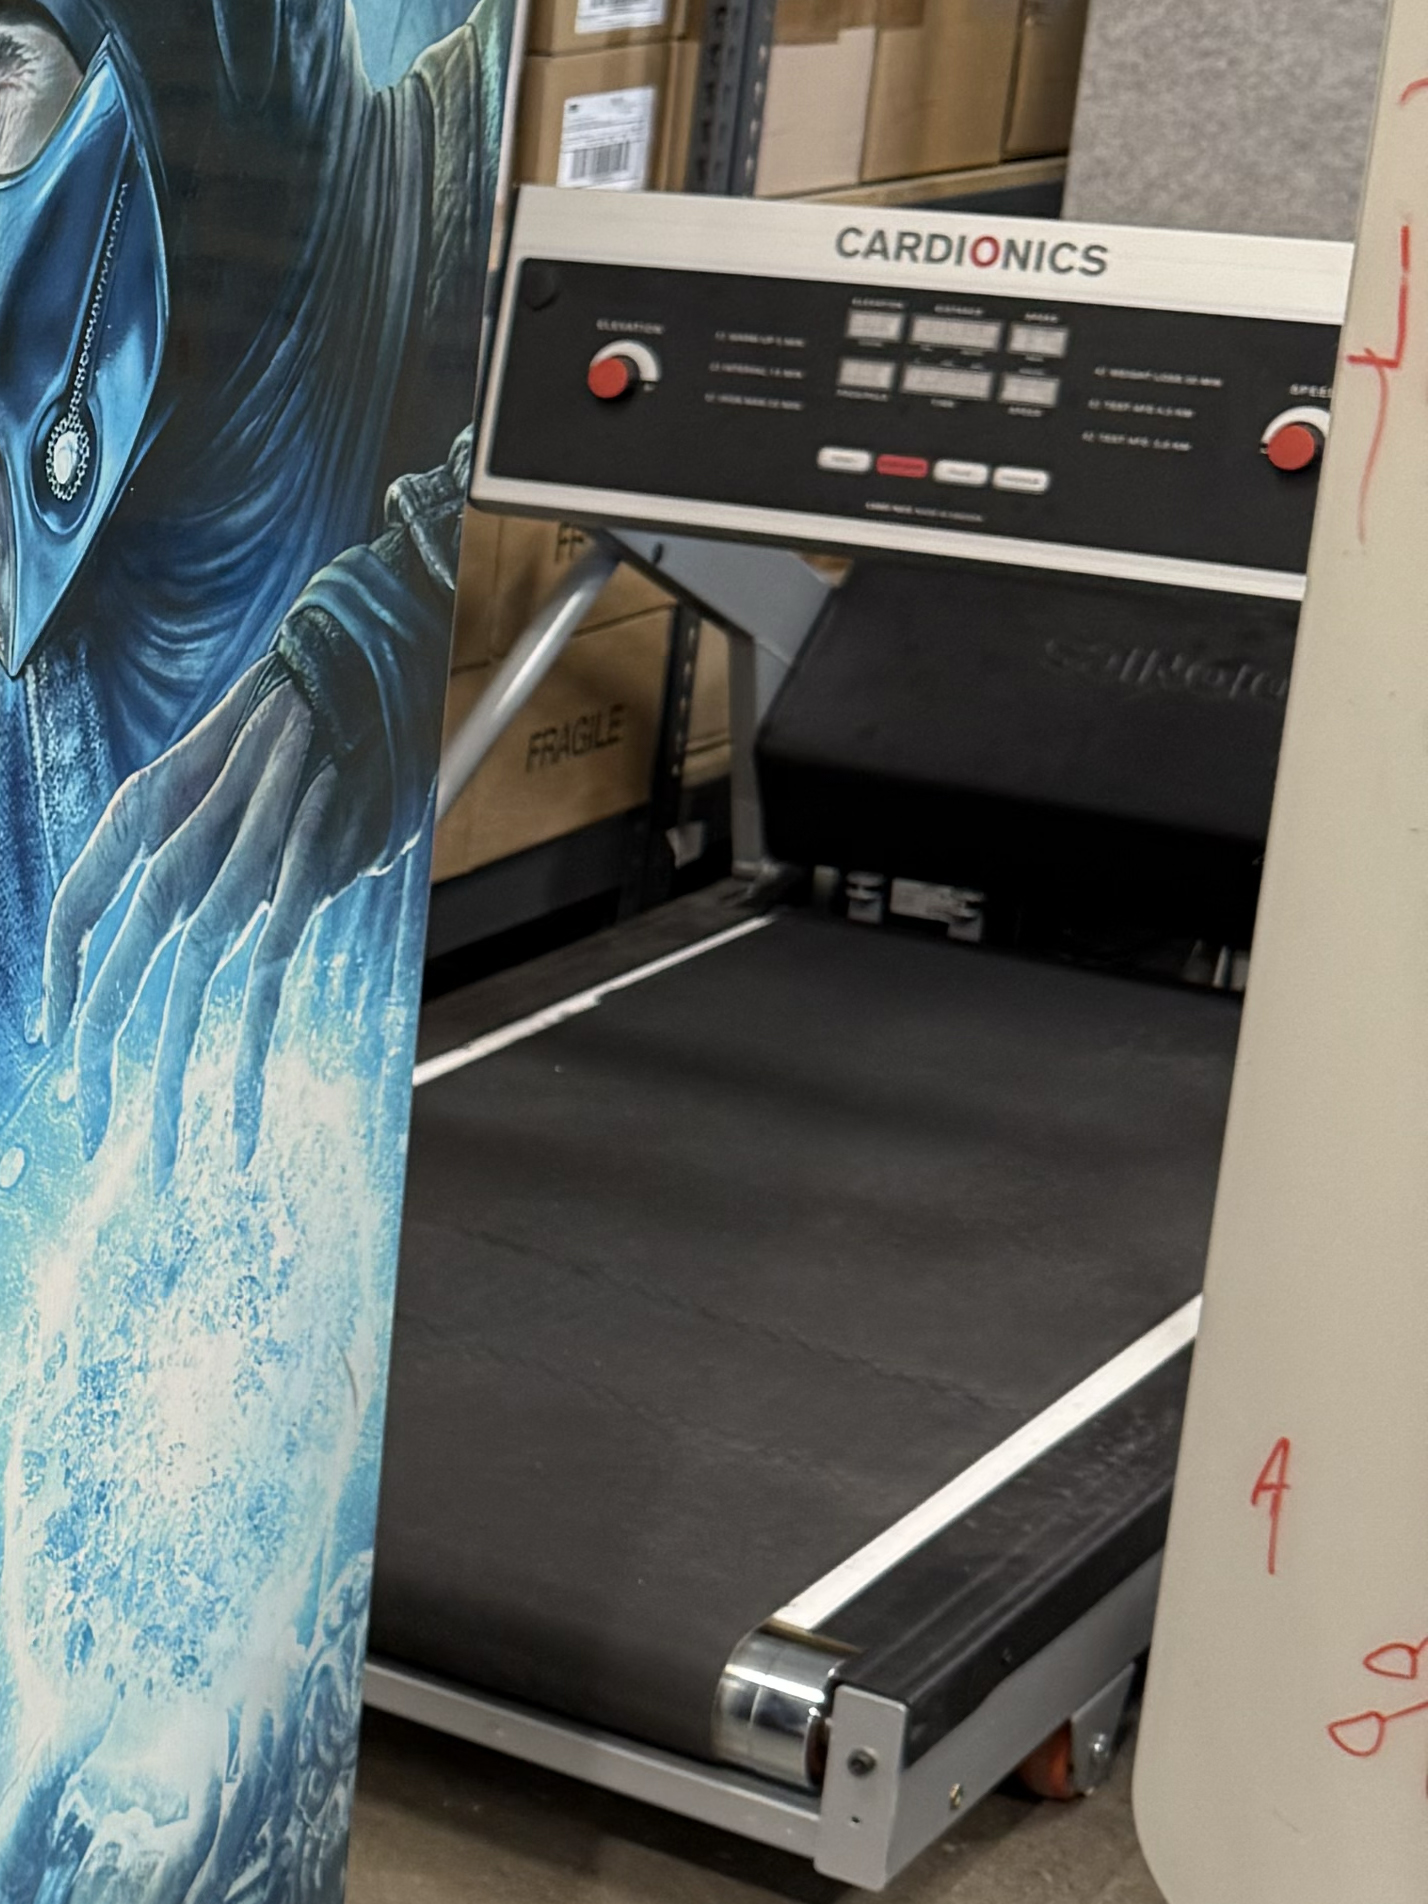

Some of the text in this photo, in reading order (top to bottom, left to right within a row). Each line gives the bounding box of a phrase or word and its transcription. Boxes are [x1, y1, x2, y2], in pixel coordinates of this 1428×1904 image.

[835, 226, 1109, 277] CARDIONICS
[1289, 383, 1332, 399] SPEE
[526, 702, 625, 775] FRAGILE
